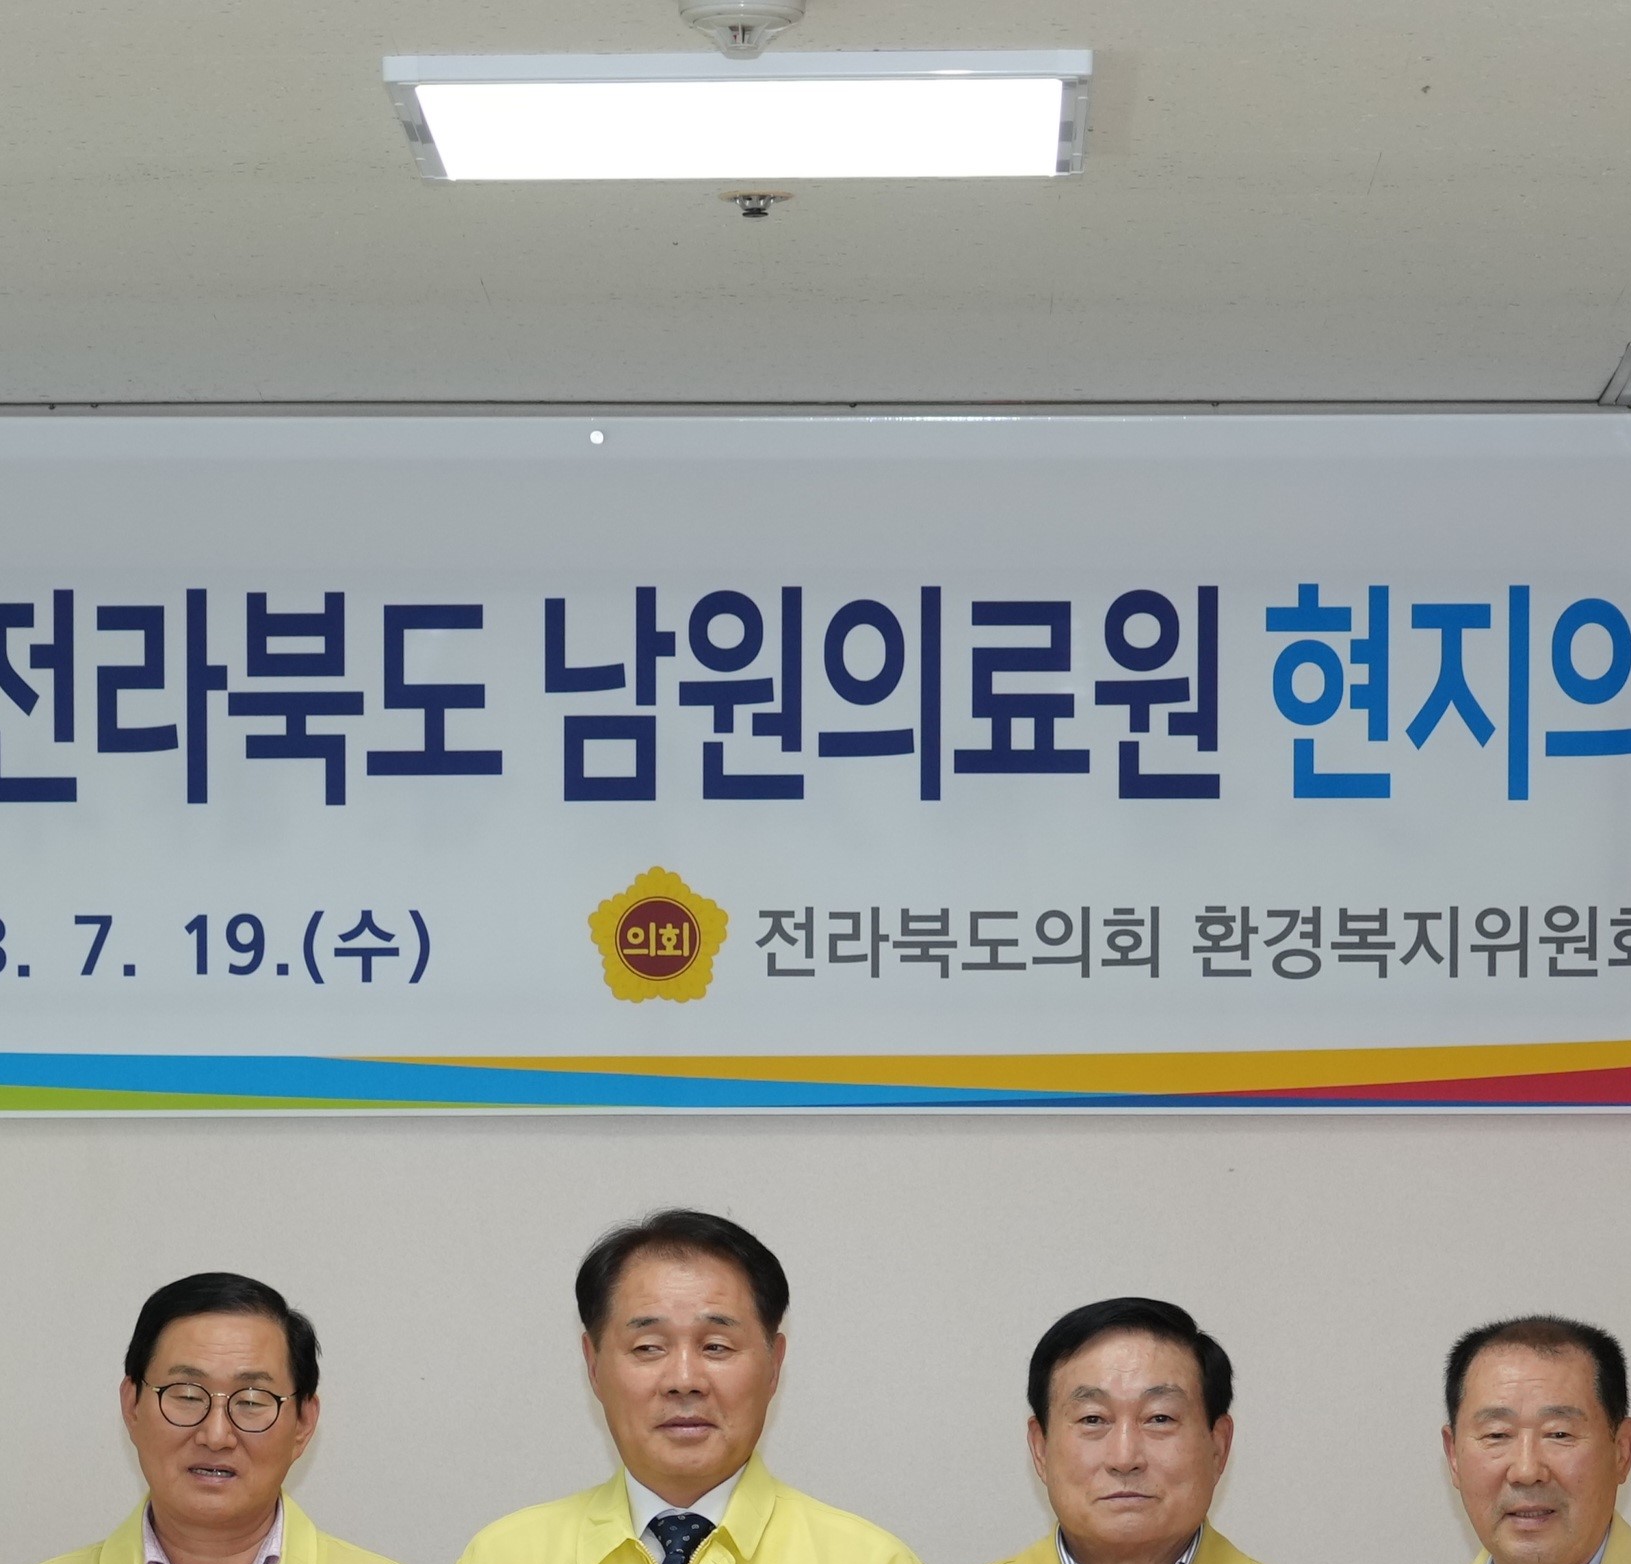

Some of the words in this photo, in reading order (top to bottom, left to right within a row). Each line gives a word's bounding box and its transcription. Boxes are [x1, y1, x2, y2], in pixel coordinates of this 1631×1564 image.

[544, 586, 1221, 802] 남원의료원
[74, 914, 136, 977] 7.
[184, 909, 431, 985] 19.(수)
[622, 921, 690, 957] 의회
[755, 906, 1160, 979] 전라북도의회
